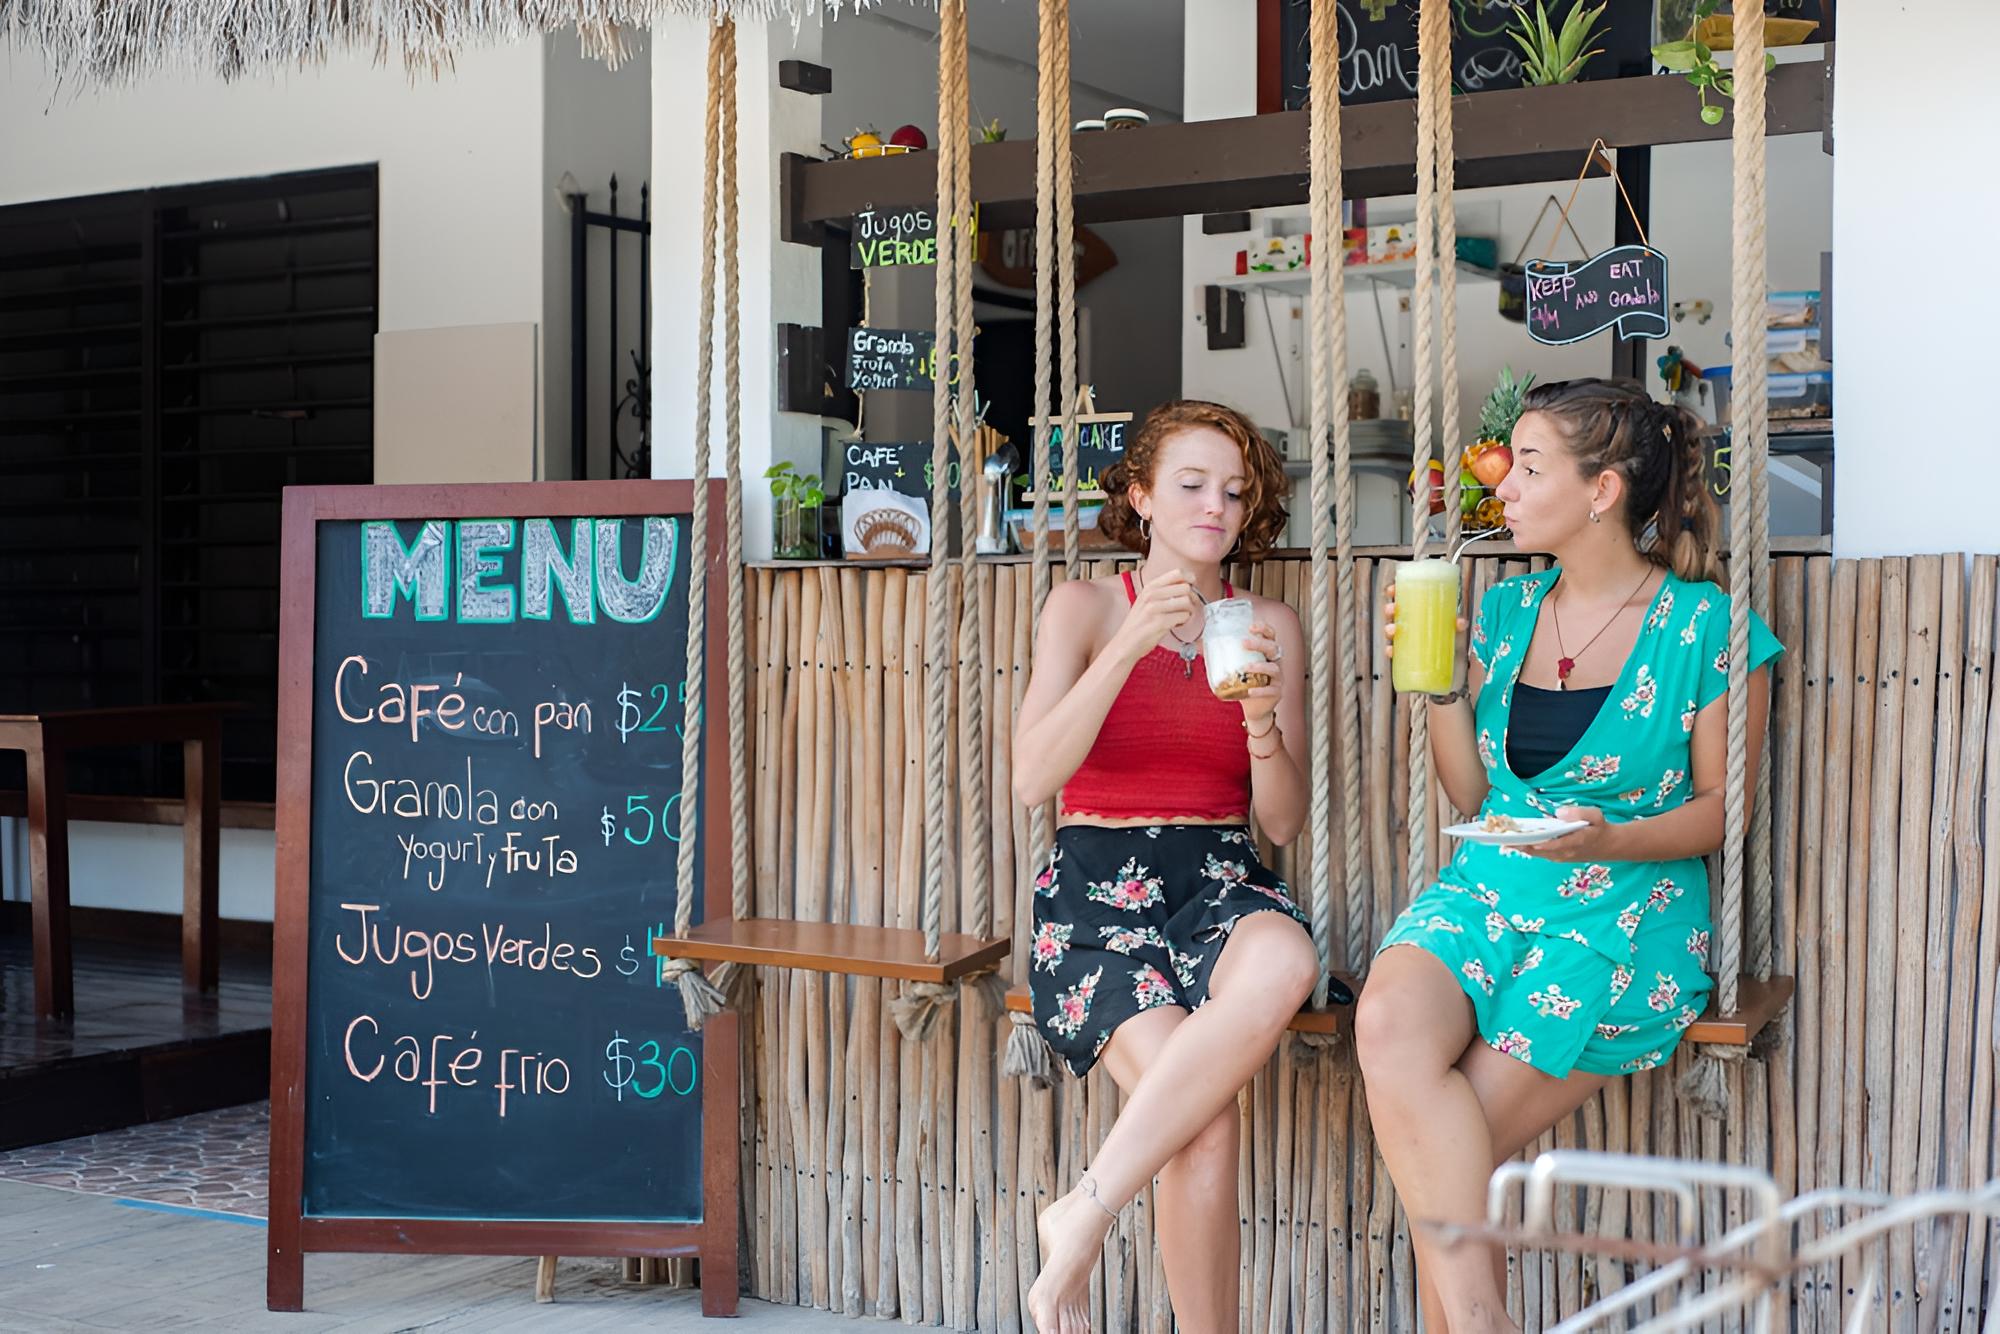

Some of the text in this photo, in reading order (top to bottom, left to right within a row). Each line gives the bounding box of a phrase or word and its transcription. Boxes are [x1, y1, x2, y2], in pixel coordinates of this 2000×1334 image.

[857, 237, 937, 268] VERDE
[1609, 259, 1643, 280] EAT
[1529, 276, 1576, 302] KEEP
[361, 516, 680, 625] MENU
[473, 706, 519, 737] con
[534, 698, 592, 759] pan
[344, 750, 498, 825] Granola
[335, 903, 476, 1000] Jugos
[482, 921, 601, 978] Verdes
[344, 1014, 697, 1118] Café frio $30
